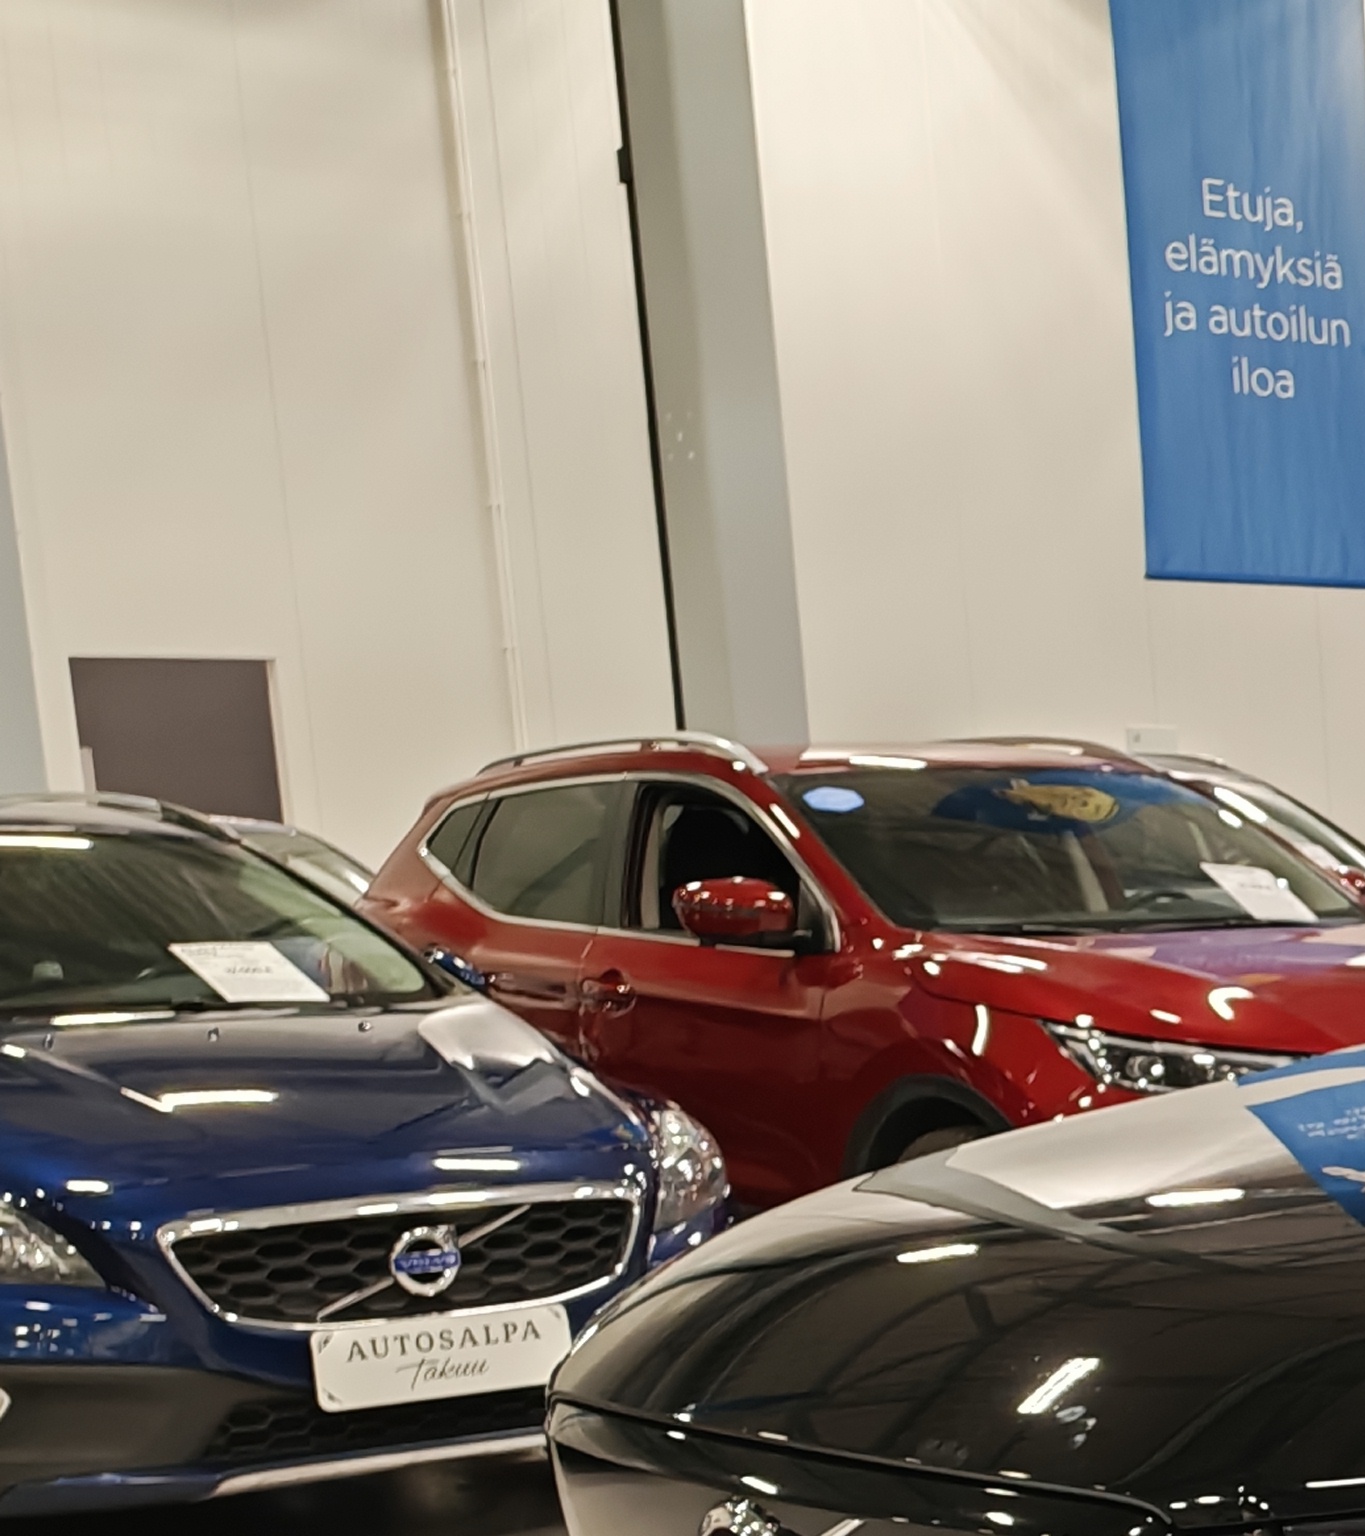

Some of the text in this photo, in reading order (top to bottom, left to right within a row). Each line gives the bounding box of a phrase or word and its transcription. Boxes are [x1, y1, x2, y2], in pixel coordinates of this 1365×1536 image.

[1202, 177, 1303, 233] Etuja,
[1164, 232, 1343, 290] elämyksiä
[1163, 290, 1351, 348] ja autoilun
[1231, 356, 1296, 399] iloa
[346, 1319, 541, 1363] AUTOSALPA
[395, 1357, 490, 1392] Takuu
